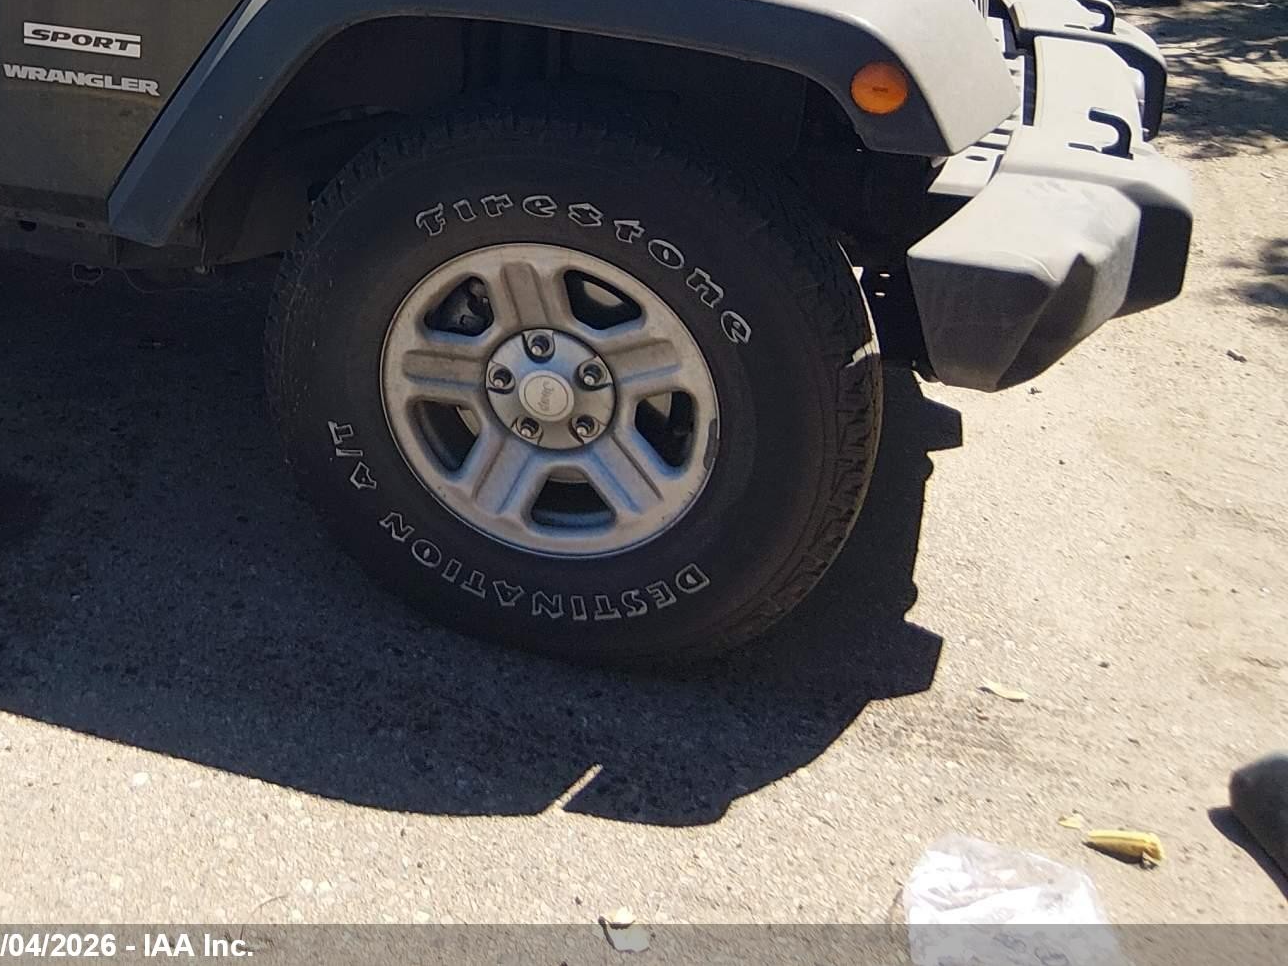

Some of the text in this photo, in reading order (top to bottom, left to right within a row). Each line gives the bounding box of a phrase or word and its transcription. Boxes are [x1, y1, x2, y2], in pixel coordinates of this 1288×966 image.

[3, 63, 160, 96] WRANGLER
[31, 29, 136, 51] SPORT
[415, 193, 753, 345] Firestone
[327, 419, 711, 622] DESTINATION A/T
